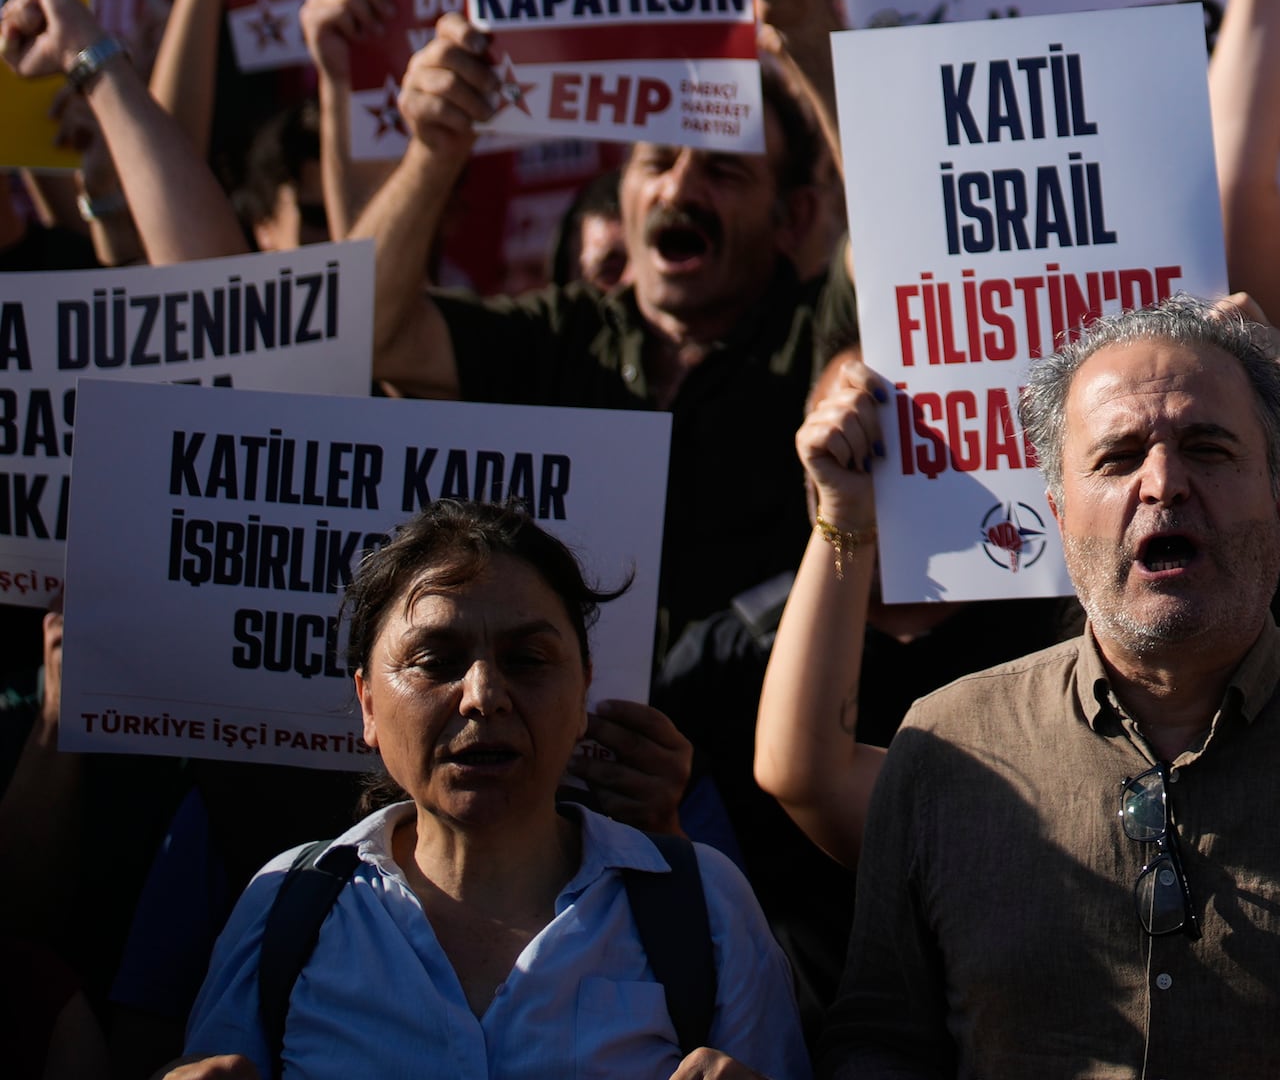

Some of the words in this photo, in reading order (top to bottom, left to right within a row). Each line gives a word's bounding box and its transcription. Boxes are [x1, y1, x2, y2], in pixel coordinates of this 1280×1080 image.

[547, 71, 674, 127] EHP
[939, 41, 1099, 146] KATİL
[938, 151, 1119, 256] İSRAİL
[56, 260, 340, 371] DÜZENİNİZİ
[168, 428, 385, 511] KATİLLER
[401, 446, 572, 521] KADAR
[81, 710, 206, 740] TÜRKİYE
[212, 718, 268, 749] İŞÇİ
[273, 728, 381, 756] PARTİS
